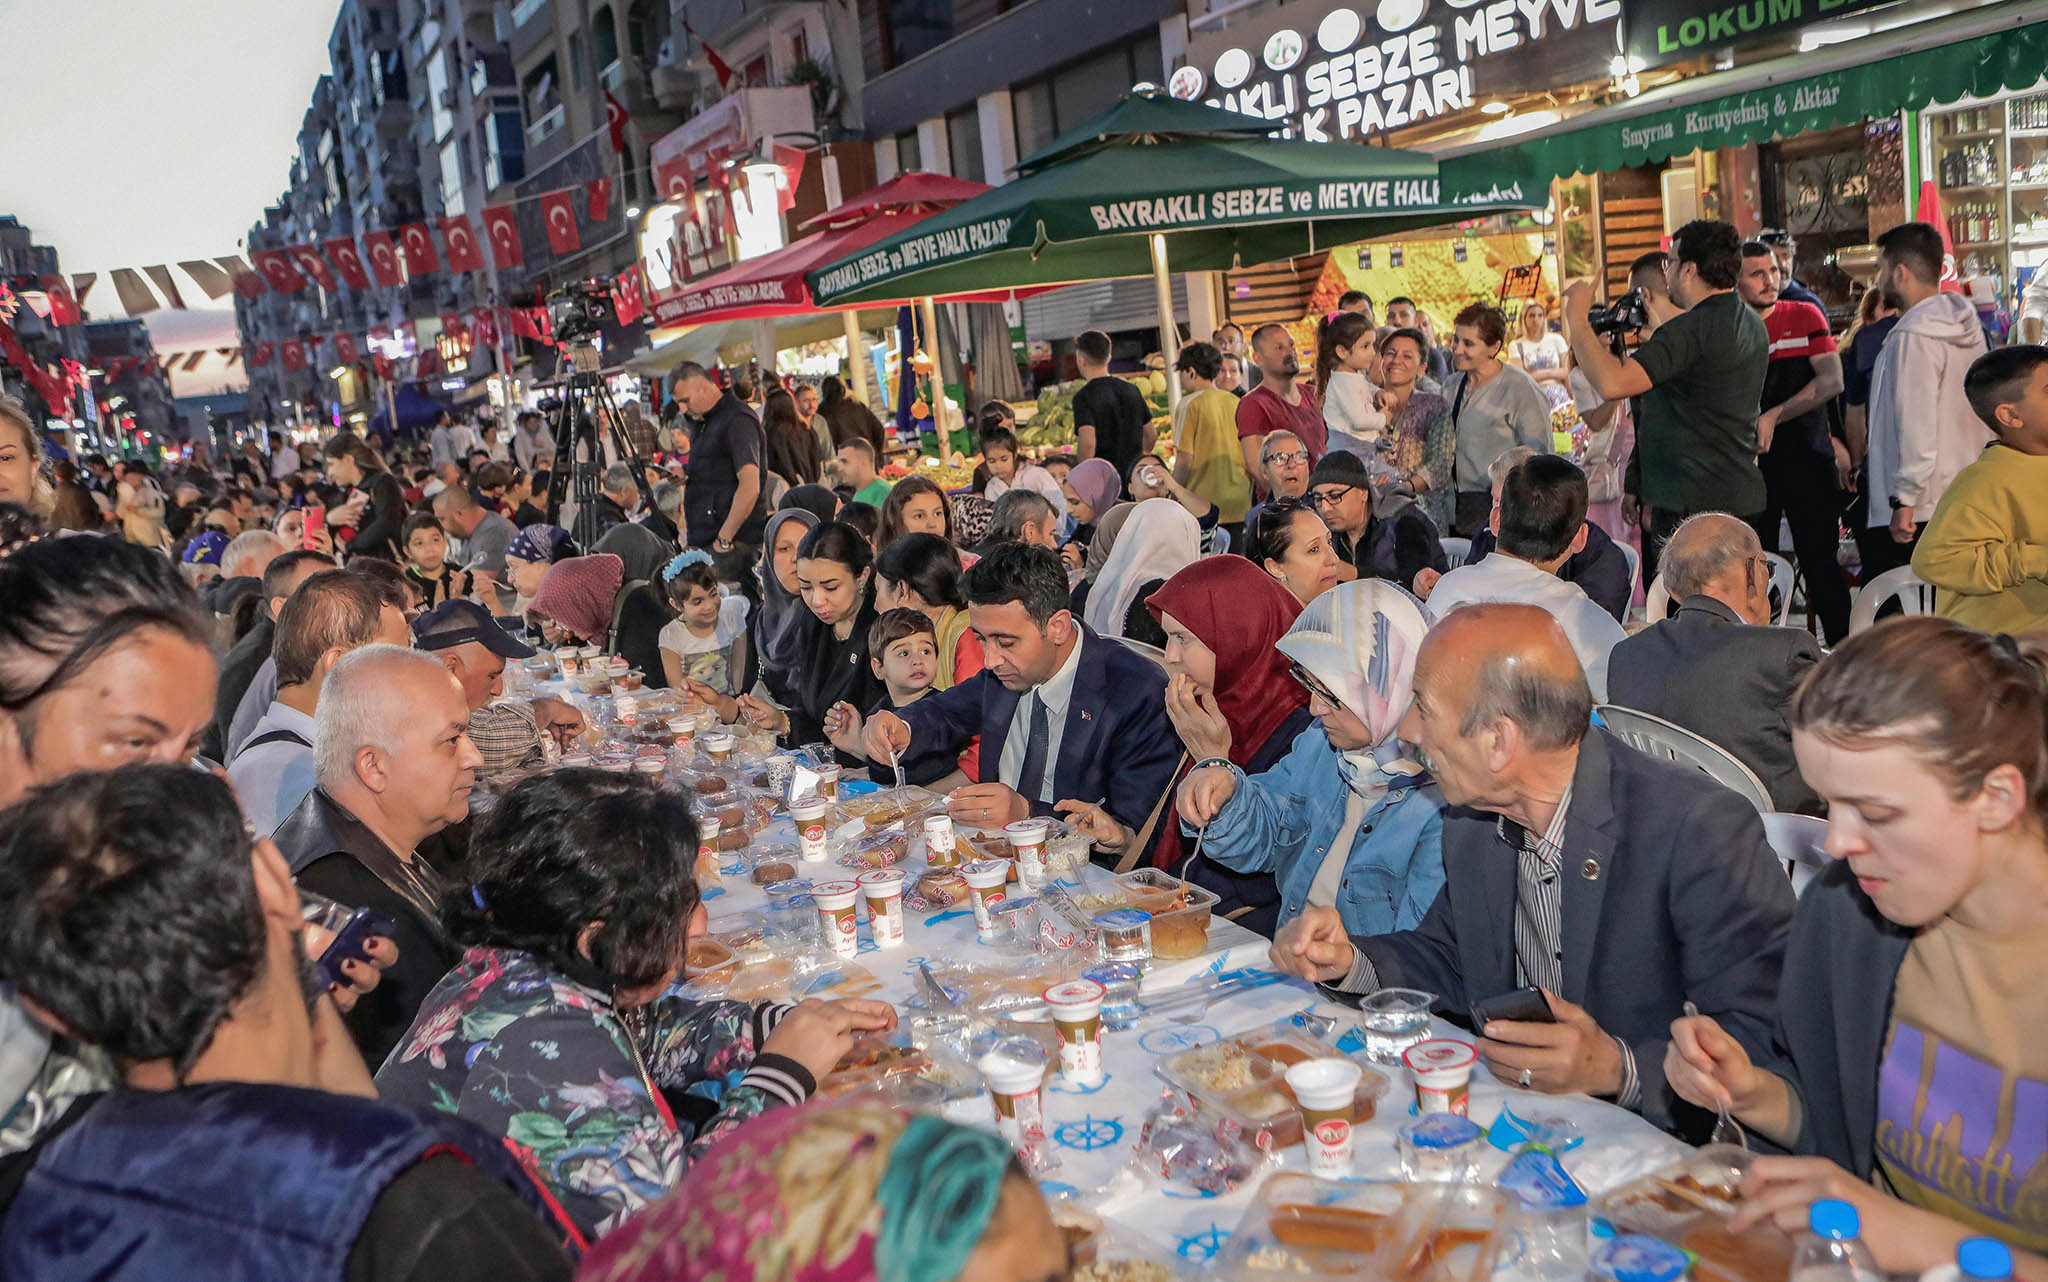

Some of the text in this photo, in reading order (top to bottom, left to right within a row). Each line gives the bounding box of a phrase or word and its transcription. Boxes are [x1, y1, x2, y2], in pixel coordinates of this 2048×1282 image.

[1657, 0, 1801, 54] LOKUM
[1305, 25, 1440, 107] SEBZE
[1338, 65, 1471, 140] PAZARI
[1622, 84, 1841, 149] Smyrna Kuruyemiş & Aktar
[1090, 194, 1206, 231] BAYRAKLI
[1212, 186, 1284, 219] SEBZE
[1289, 191, 1312, 212] ve
[1318, 181, 1389, 210] MEYVE
[818, 263, 860, 298] BAYRAKLI
[859, 251, 890, 282] SEBZE
[900, 234, 938, 268] MEYVE
[936, 226, 971, 259] HALK
